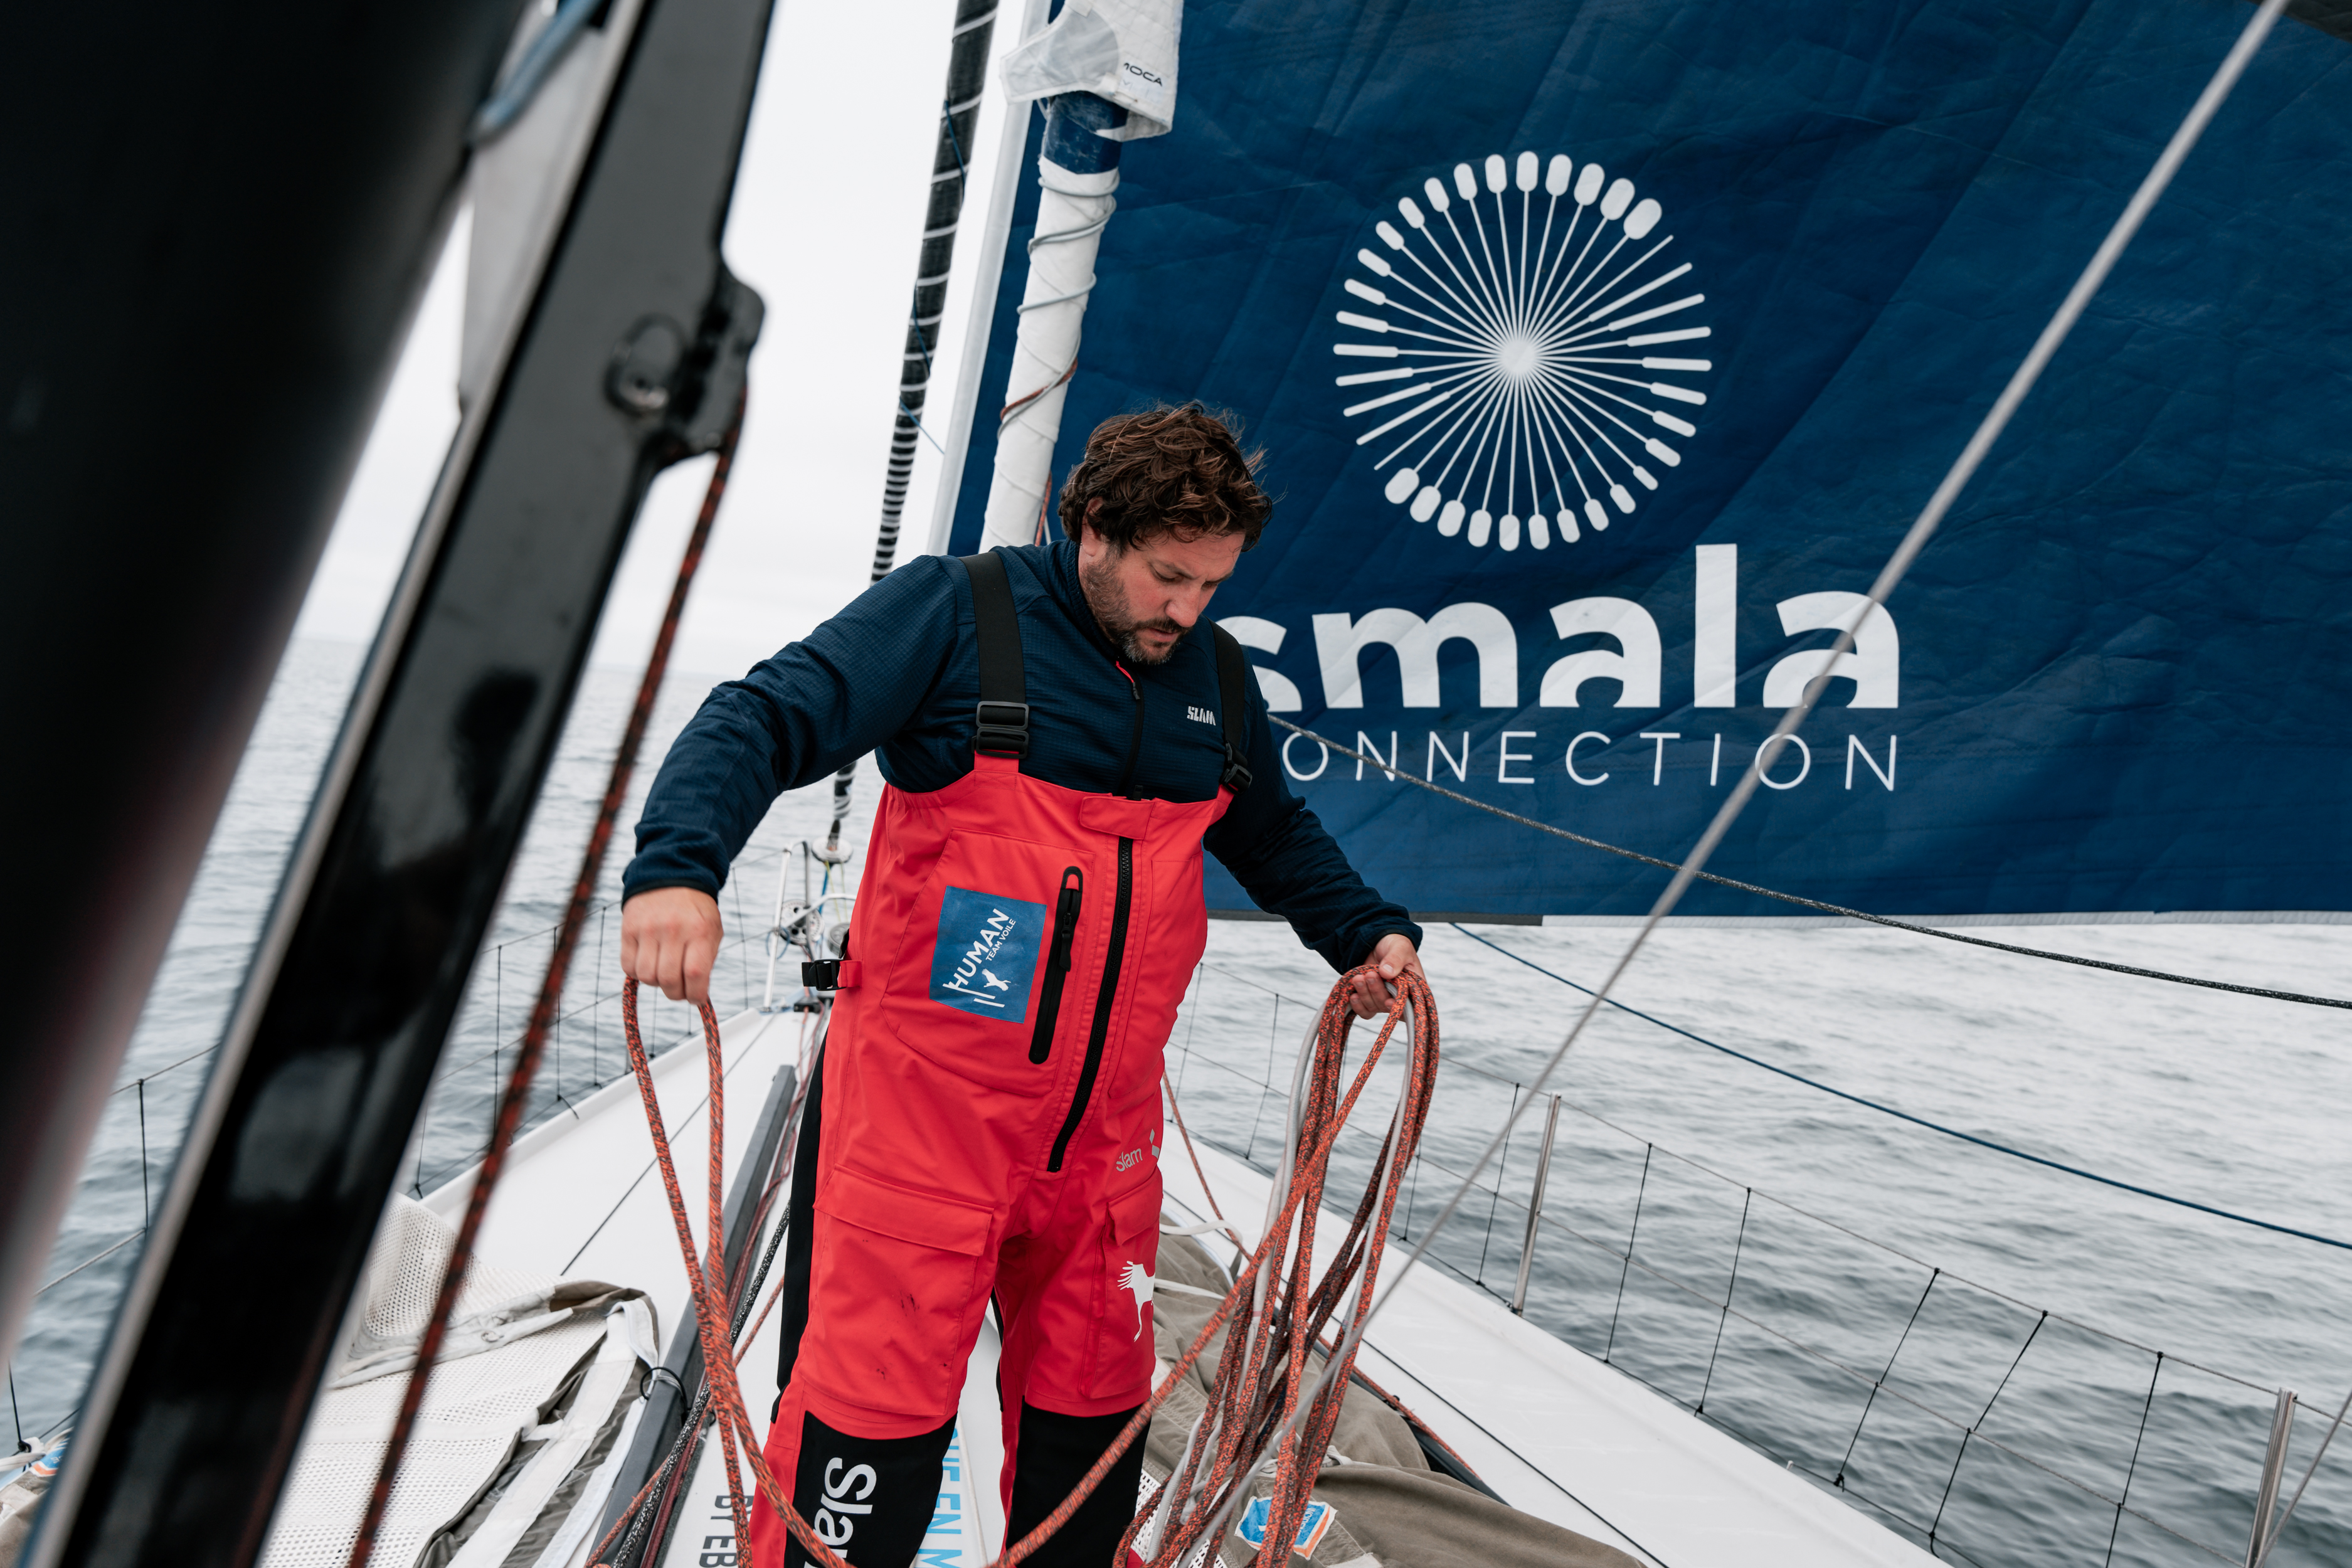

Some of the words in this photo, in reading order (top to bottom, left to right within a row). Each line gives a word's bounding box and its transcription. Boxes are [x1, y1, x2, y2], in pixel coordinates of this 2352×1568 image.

[1216, 543, 1899, 712] smala
[1187, 706, 1216, 726] SLAM
[1282, 730, 1897, 792] ONNECTION
[943, 908, 1010, 990] HUMAN
[985, 941, 1002, 961] TEAM
[999, 918, 1016, 940] VOILE
[804, 1457, 877, 1568] Sla
